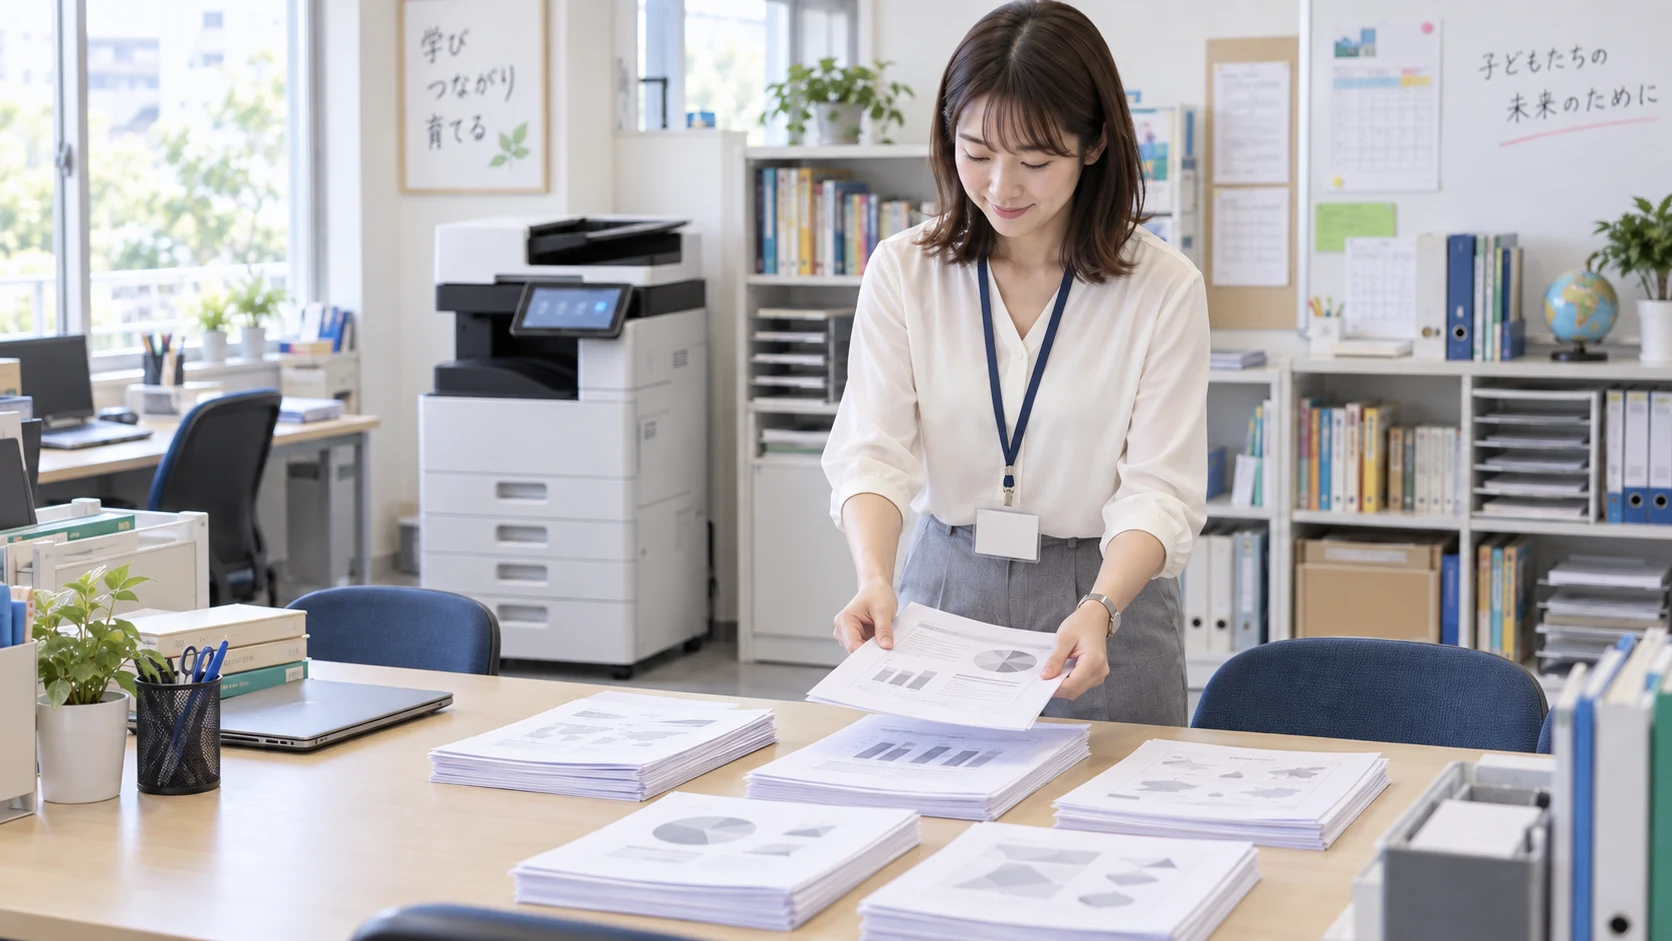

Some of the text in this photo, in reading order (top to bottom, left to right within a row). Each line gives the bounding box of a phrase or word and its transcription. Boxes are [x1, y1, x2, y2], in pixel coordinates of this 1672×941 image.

[420, 25, 470, 64] 学び
[1478, 44, 1608, 81] 子どもたちの
[427, 65, 515, 103] つながり
[1507, 84, 1659, 123] 未来のために
[425, 113, 487, 150] 育てる
